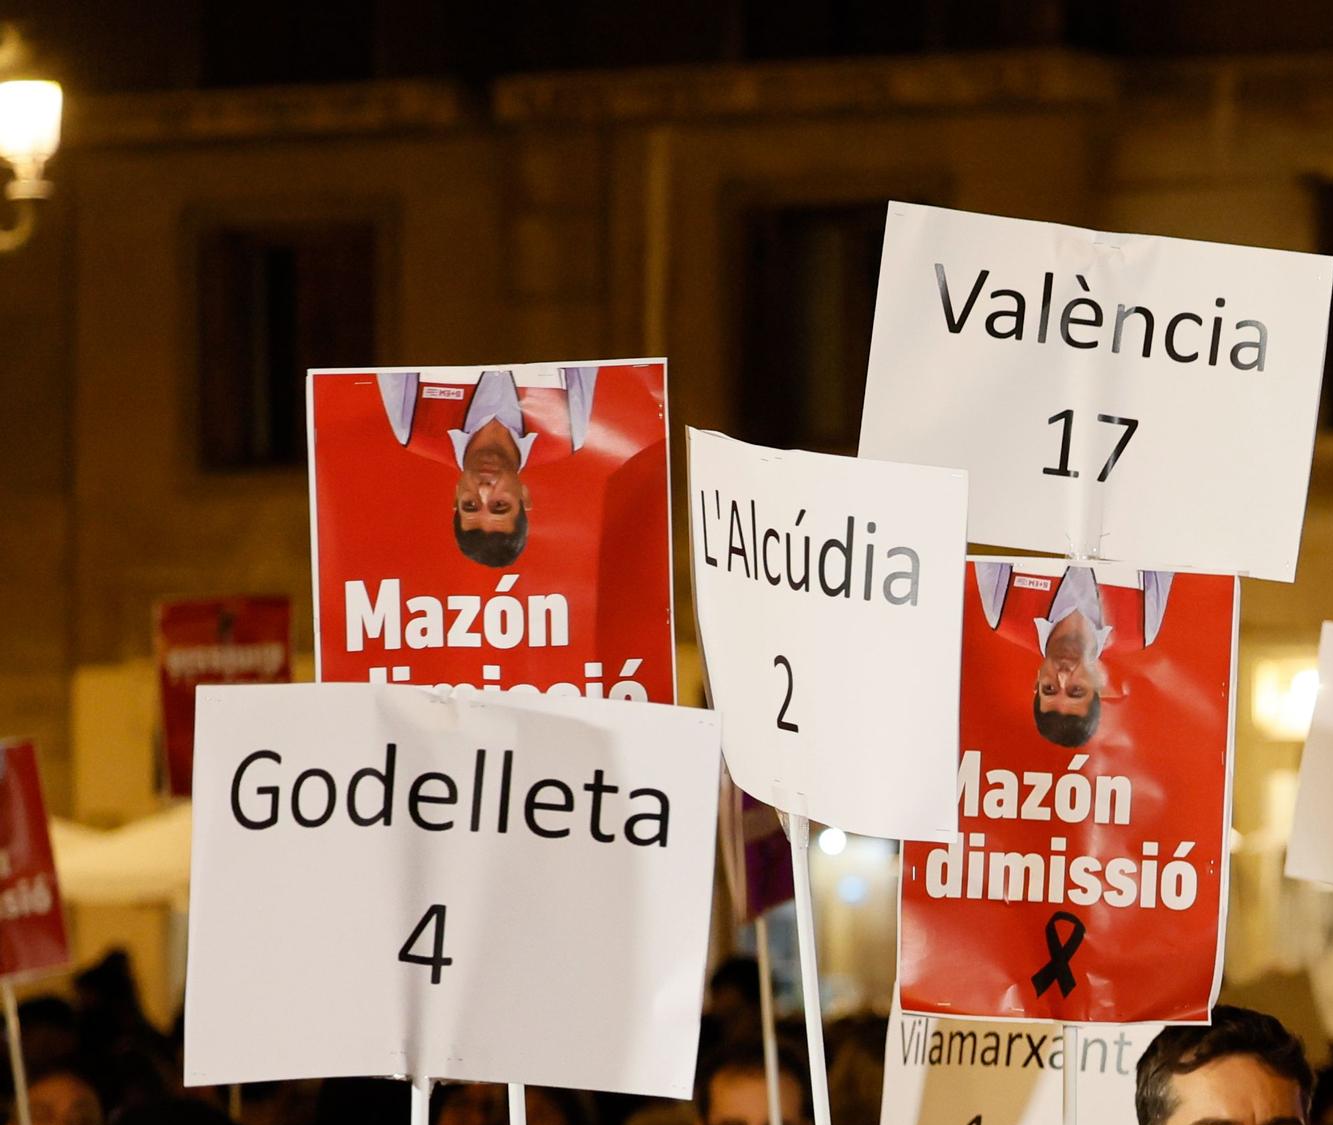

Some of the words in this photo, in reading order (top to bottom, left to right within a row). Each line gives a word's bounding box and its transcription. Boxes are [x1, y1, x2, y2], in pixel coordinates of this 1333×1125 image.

[935, 264, 1268, 371] València
[1043, 409, 1138, 482] 17
[700, 490, 920, 607] L'Alcúdia
[345, 575, 568, 651] Mazón
[774, 655, 798, 733] 2
[231, 743, 669, 847] Godelleta
[958, 750, 1132, 825] Mazón
[926, 832, 1198, 911] dimissió
[398, 904, 452, 984] 4
[901, 1018, 1132, 1075] Vilamarxant
